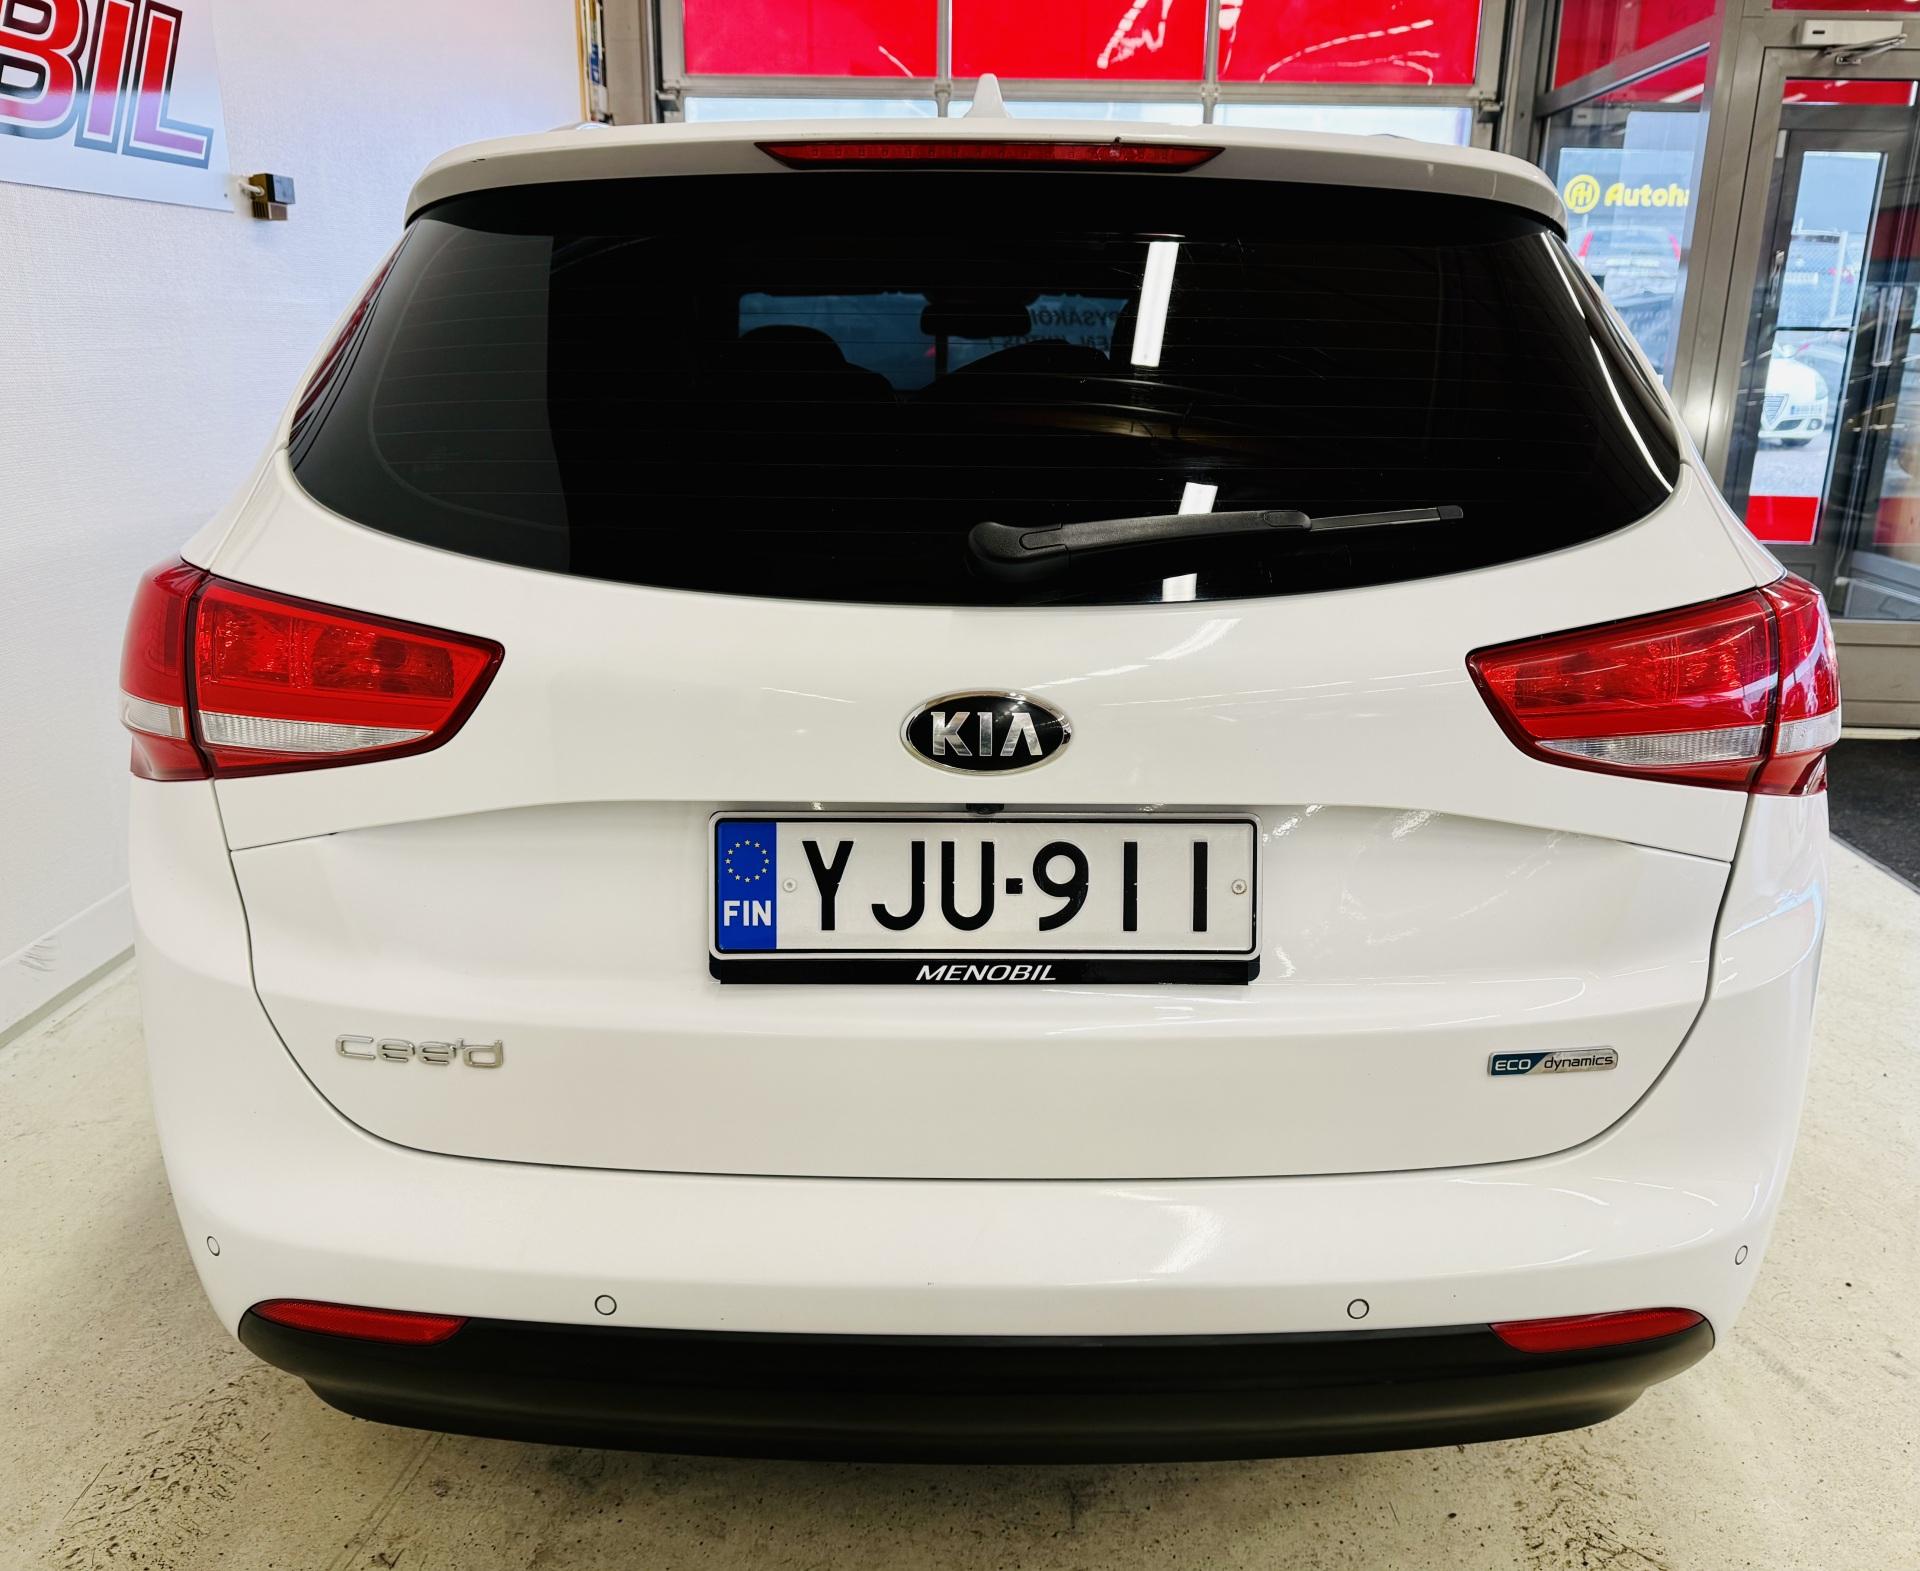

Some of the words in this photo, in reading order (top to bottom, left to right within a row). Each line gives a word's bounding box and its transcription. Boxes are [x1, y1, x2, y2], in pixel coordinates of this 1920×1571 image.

[1603, 182, 1690, 208] Autoh
[932, 711, 1043, 756] KIA
[801, 839, 1208, 932] YJU-911
[723, 900, 772, 927] FIN
[915, 964, 1057, 981] MENOBIL
[1495, 1058, 1532, 1071] ECO
[1544, 1055, 1614, 1071] dynamics
